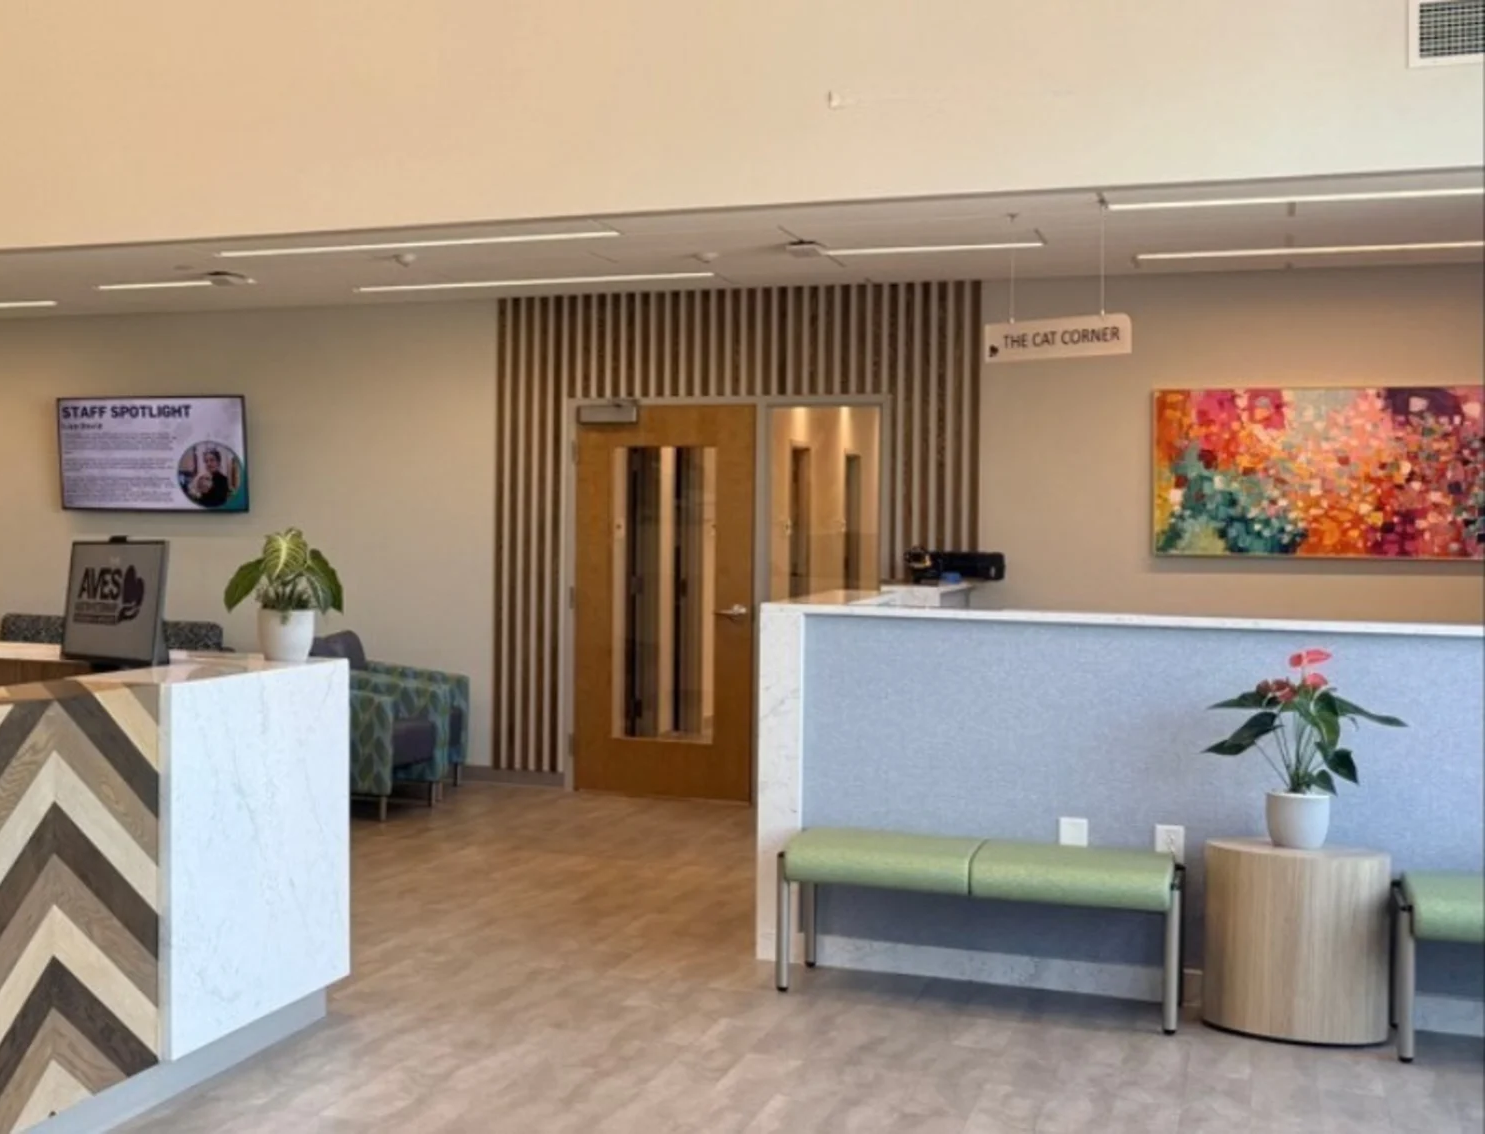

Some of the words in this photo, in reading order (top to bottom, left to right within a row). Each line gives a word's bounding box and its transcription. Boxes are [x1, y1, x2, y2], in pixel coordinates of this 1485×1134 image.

[1003, 333, 1028, 349] THE
[1032, 330, 1057, 347] CAT
[1061, 326, 1121, 345] CORNER
[62, 405, 107, 419] STAFF
[110, 404, 192, 419] SPOTLIGHT
[78, 568, 122, 600] AVES
